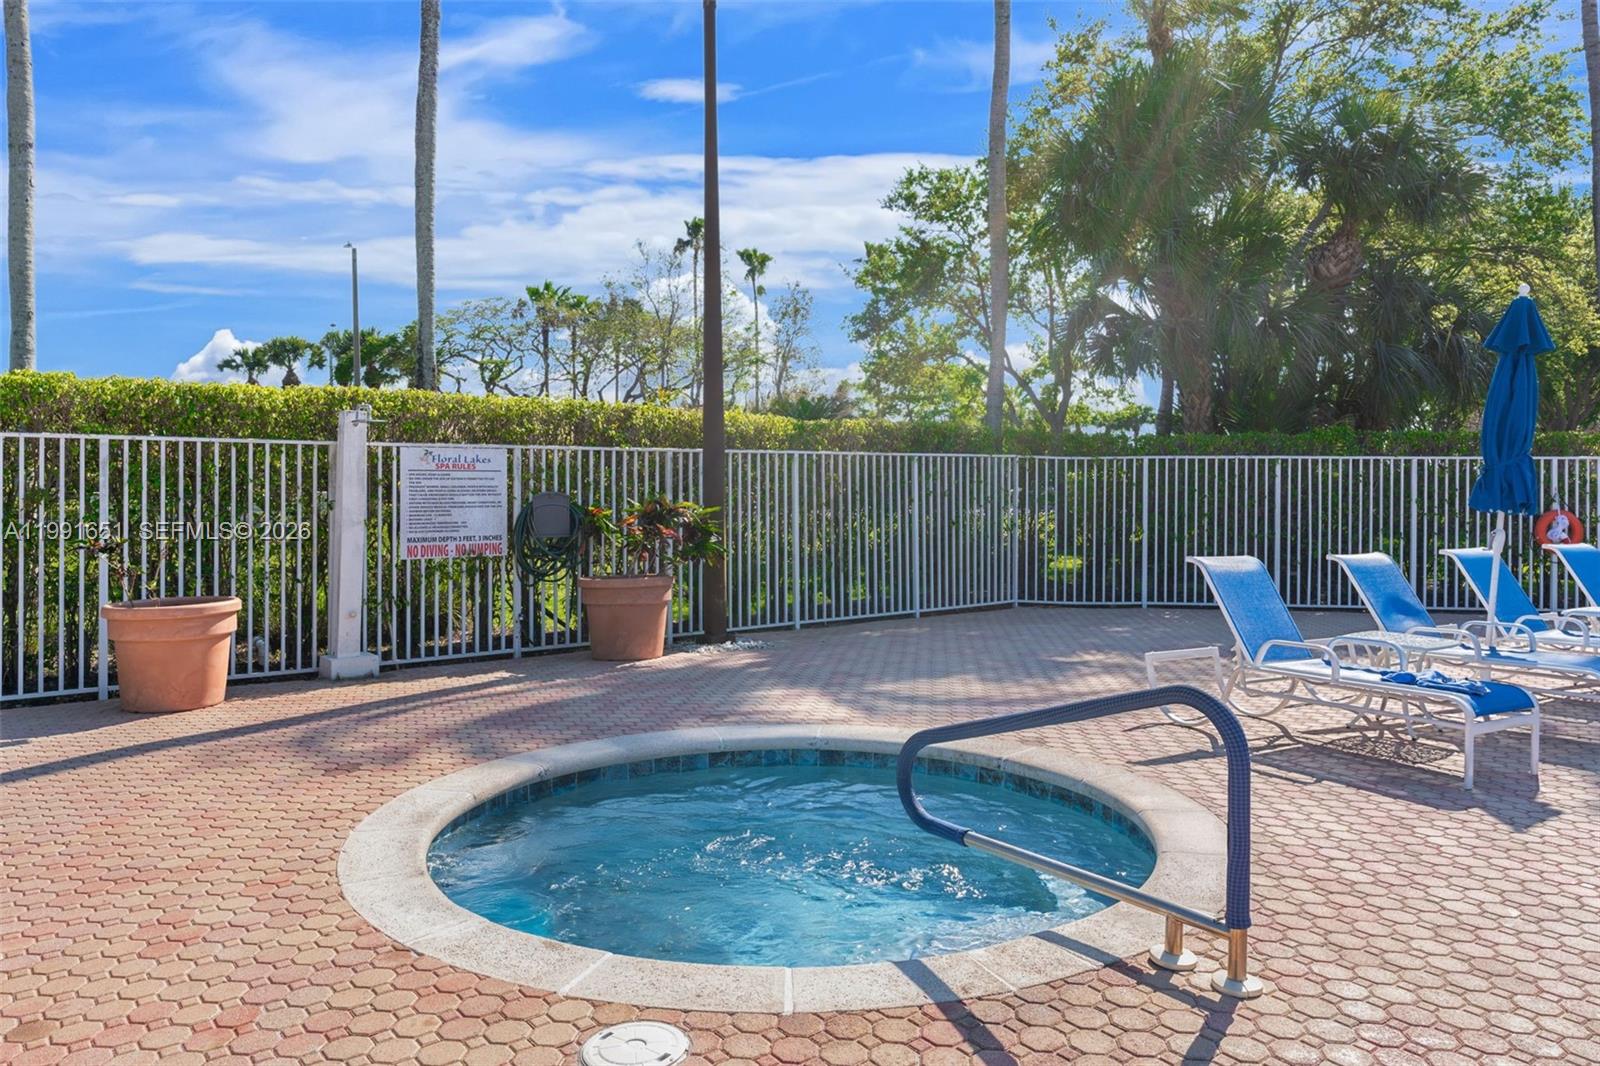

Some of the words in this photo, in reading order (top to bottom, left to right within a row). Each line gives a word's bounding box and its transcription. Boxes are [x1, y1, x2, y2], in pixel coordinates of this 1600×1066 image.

[432, 454, 461, 464] Floral
[464, 454, 491, 464] Lakes
[407, 536, 438, 544] MAXIMUM
[406, 545, 418, 558] NO
[420, 544, 449, 557] DIVING
[455, 543, 467, 556] NO
[468, 542, 502, 555] JUMPING
